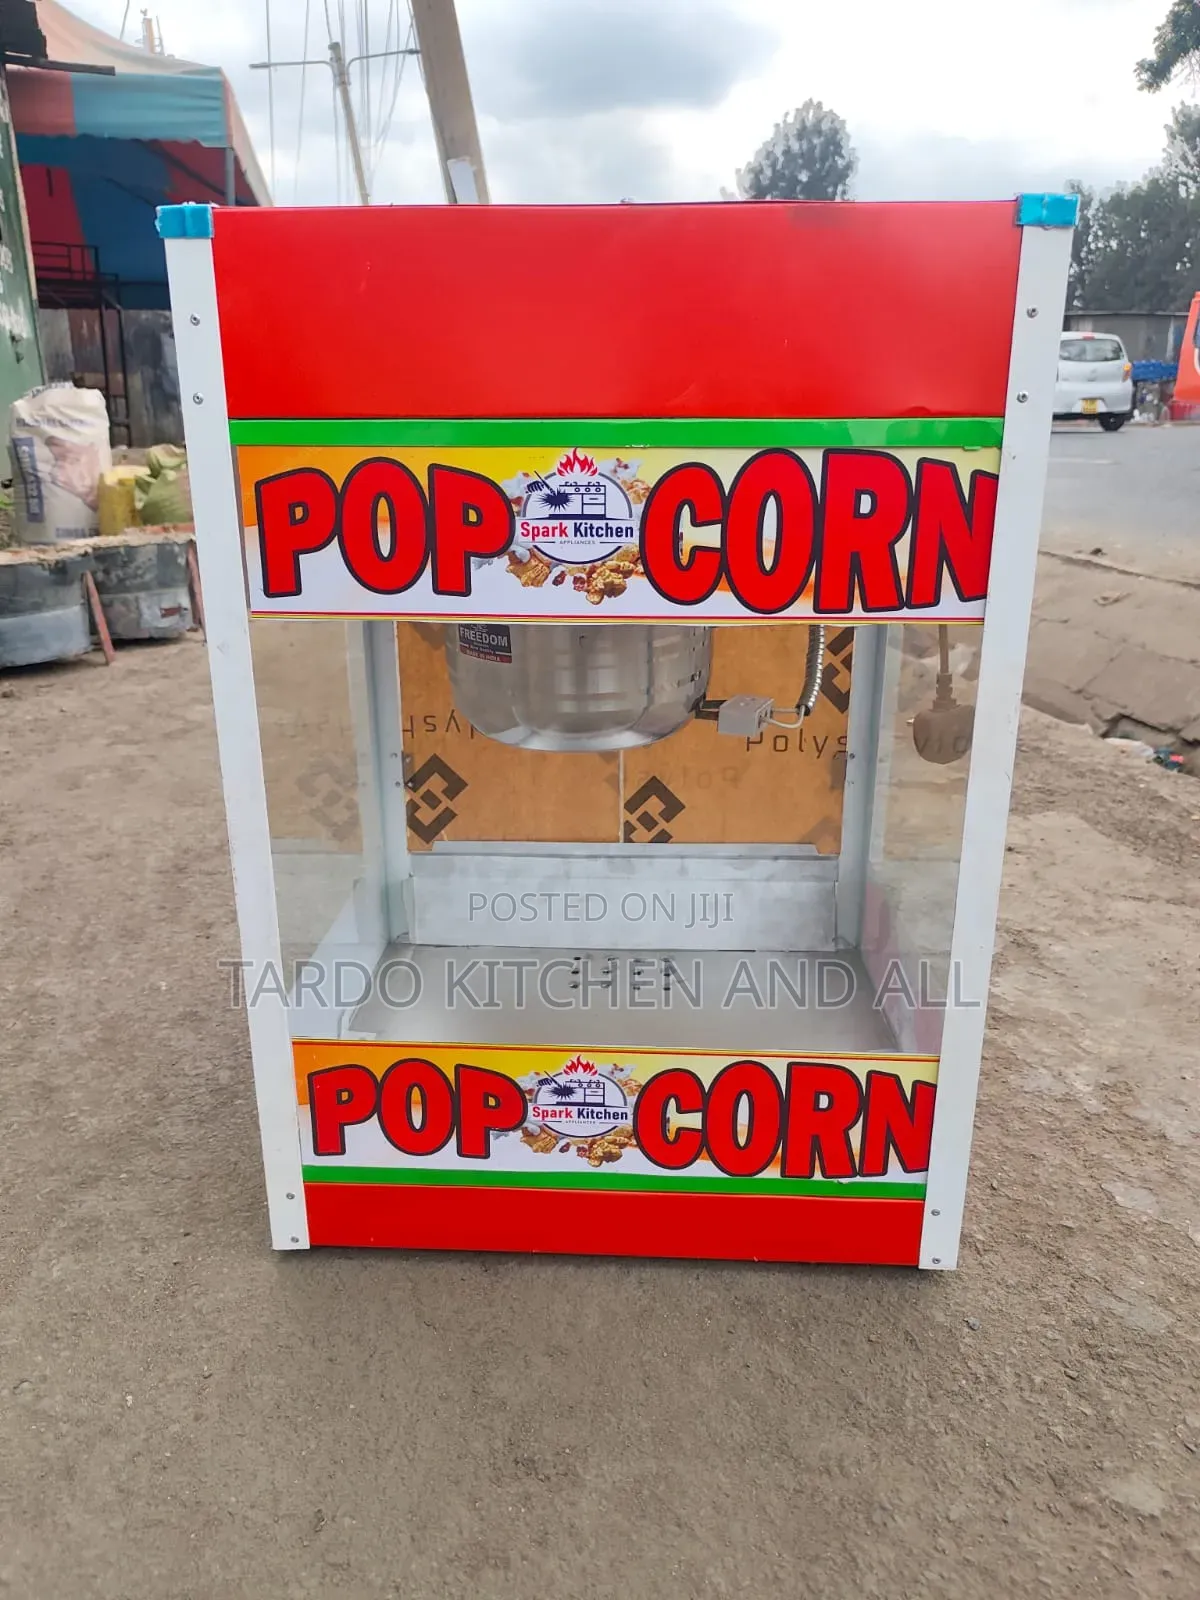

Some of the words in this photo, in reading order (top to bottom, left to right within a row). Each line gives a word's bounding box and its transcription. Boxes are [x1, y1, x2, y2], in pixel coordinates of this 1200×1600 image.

[255, 457, 515, 597] POP
[639, 448, 999, 614] CORN
[520, 521, 569, 541] Spark
[573, 522, 634, 538] Kitchen
[459, 626, 508, 648] FREEDOM
[307, 1057, 528, 1159] POP
[633, 1060, 937, 1178] CORN
[532, 1106, 573, 1120] Spark
[577, 1108, 628, 1121] Kitchen
